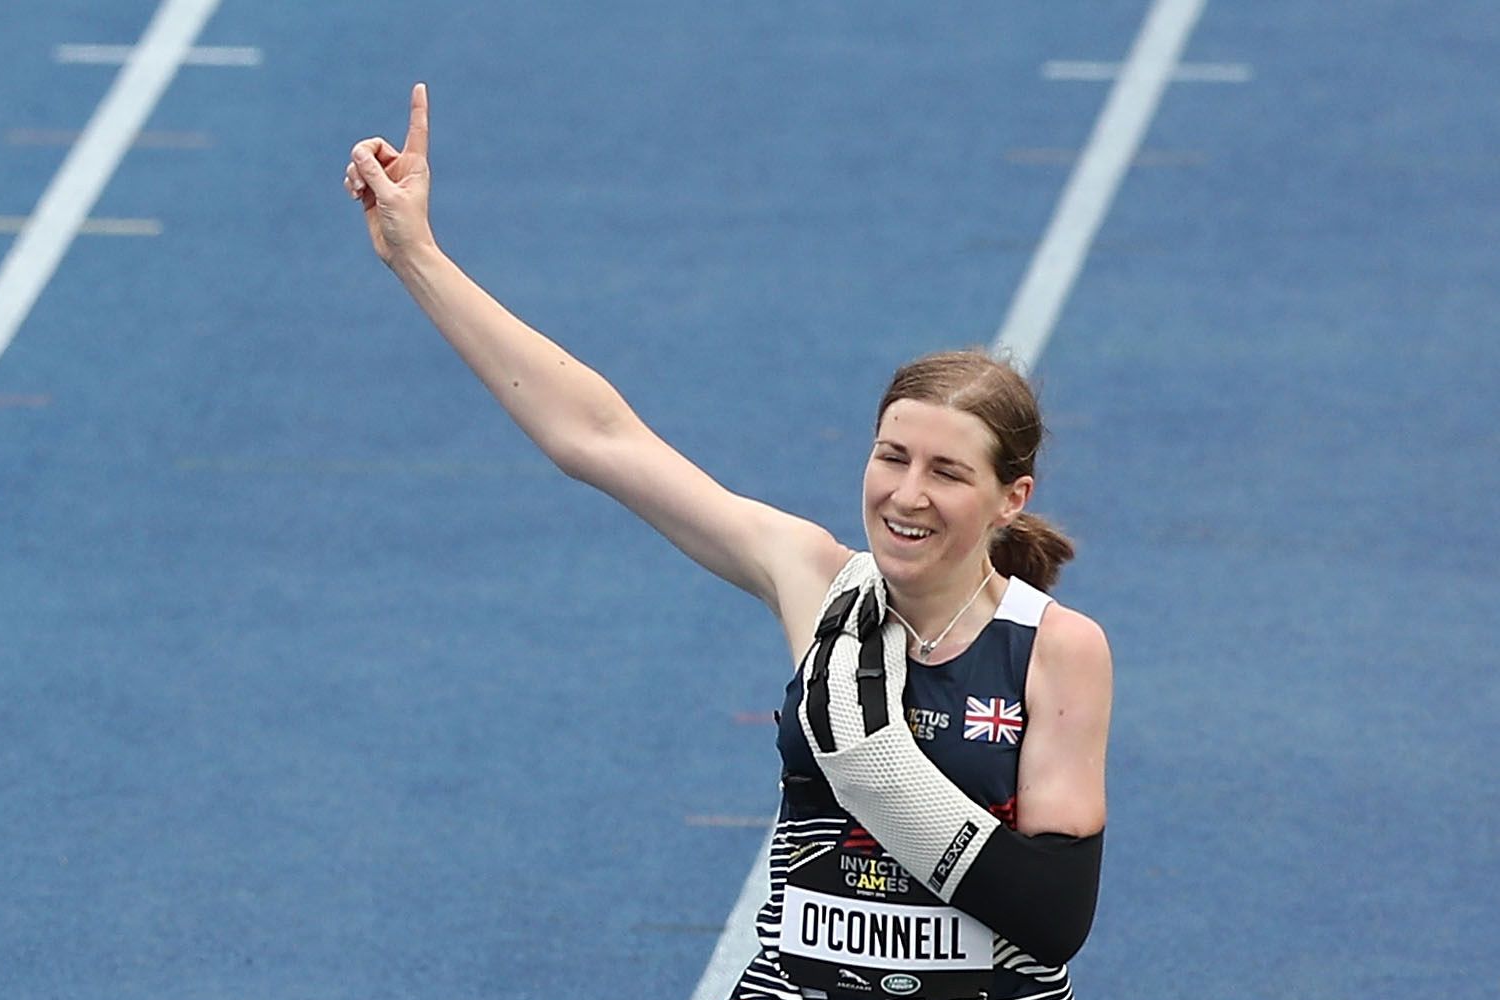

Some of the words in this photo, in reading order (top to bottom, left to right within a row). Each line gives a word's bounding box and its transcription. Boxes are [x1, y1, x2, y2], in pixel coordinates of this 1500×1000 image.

[840, 855, 910, 878] INVICTU
[845, 872, 909, 893] GAMES
[802, 902, 966, 960] O'CONNELL
